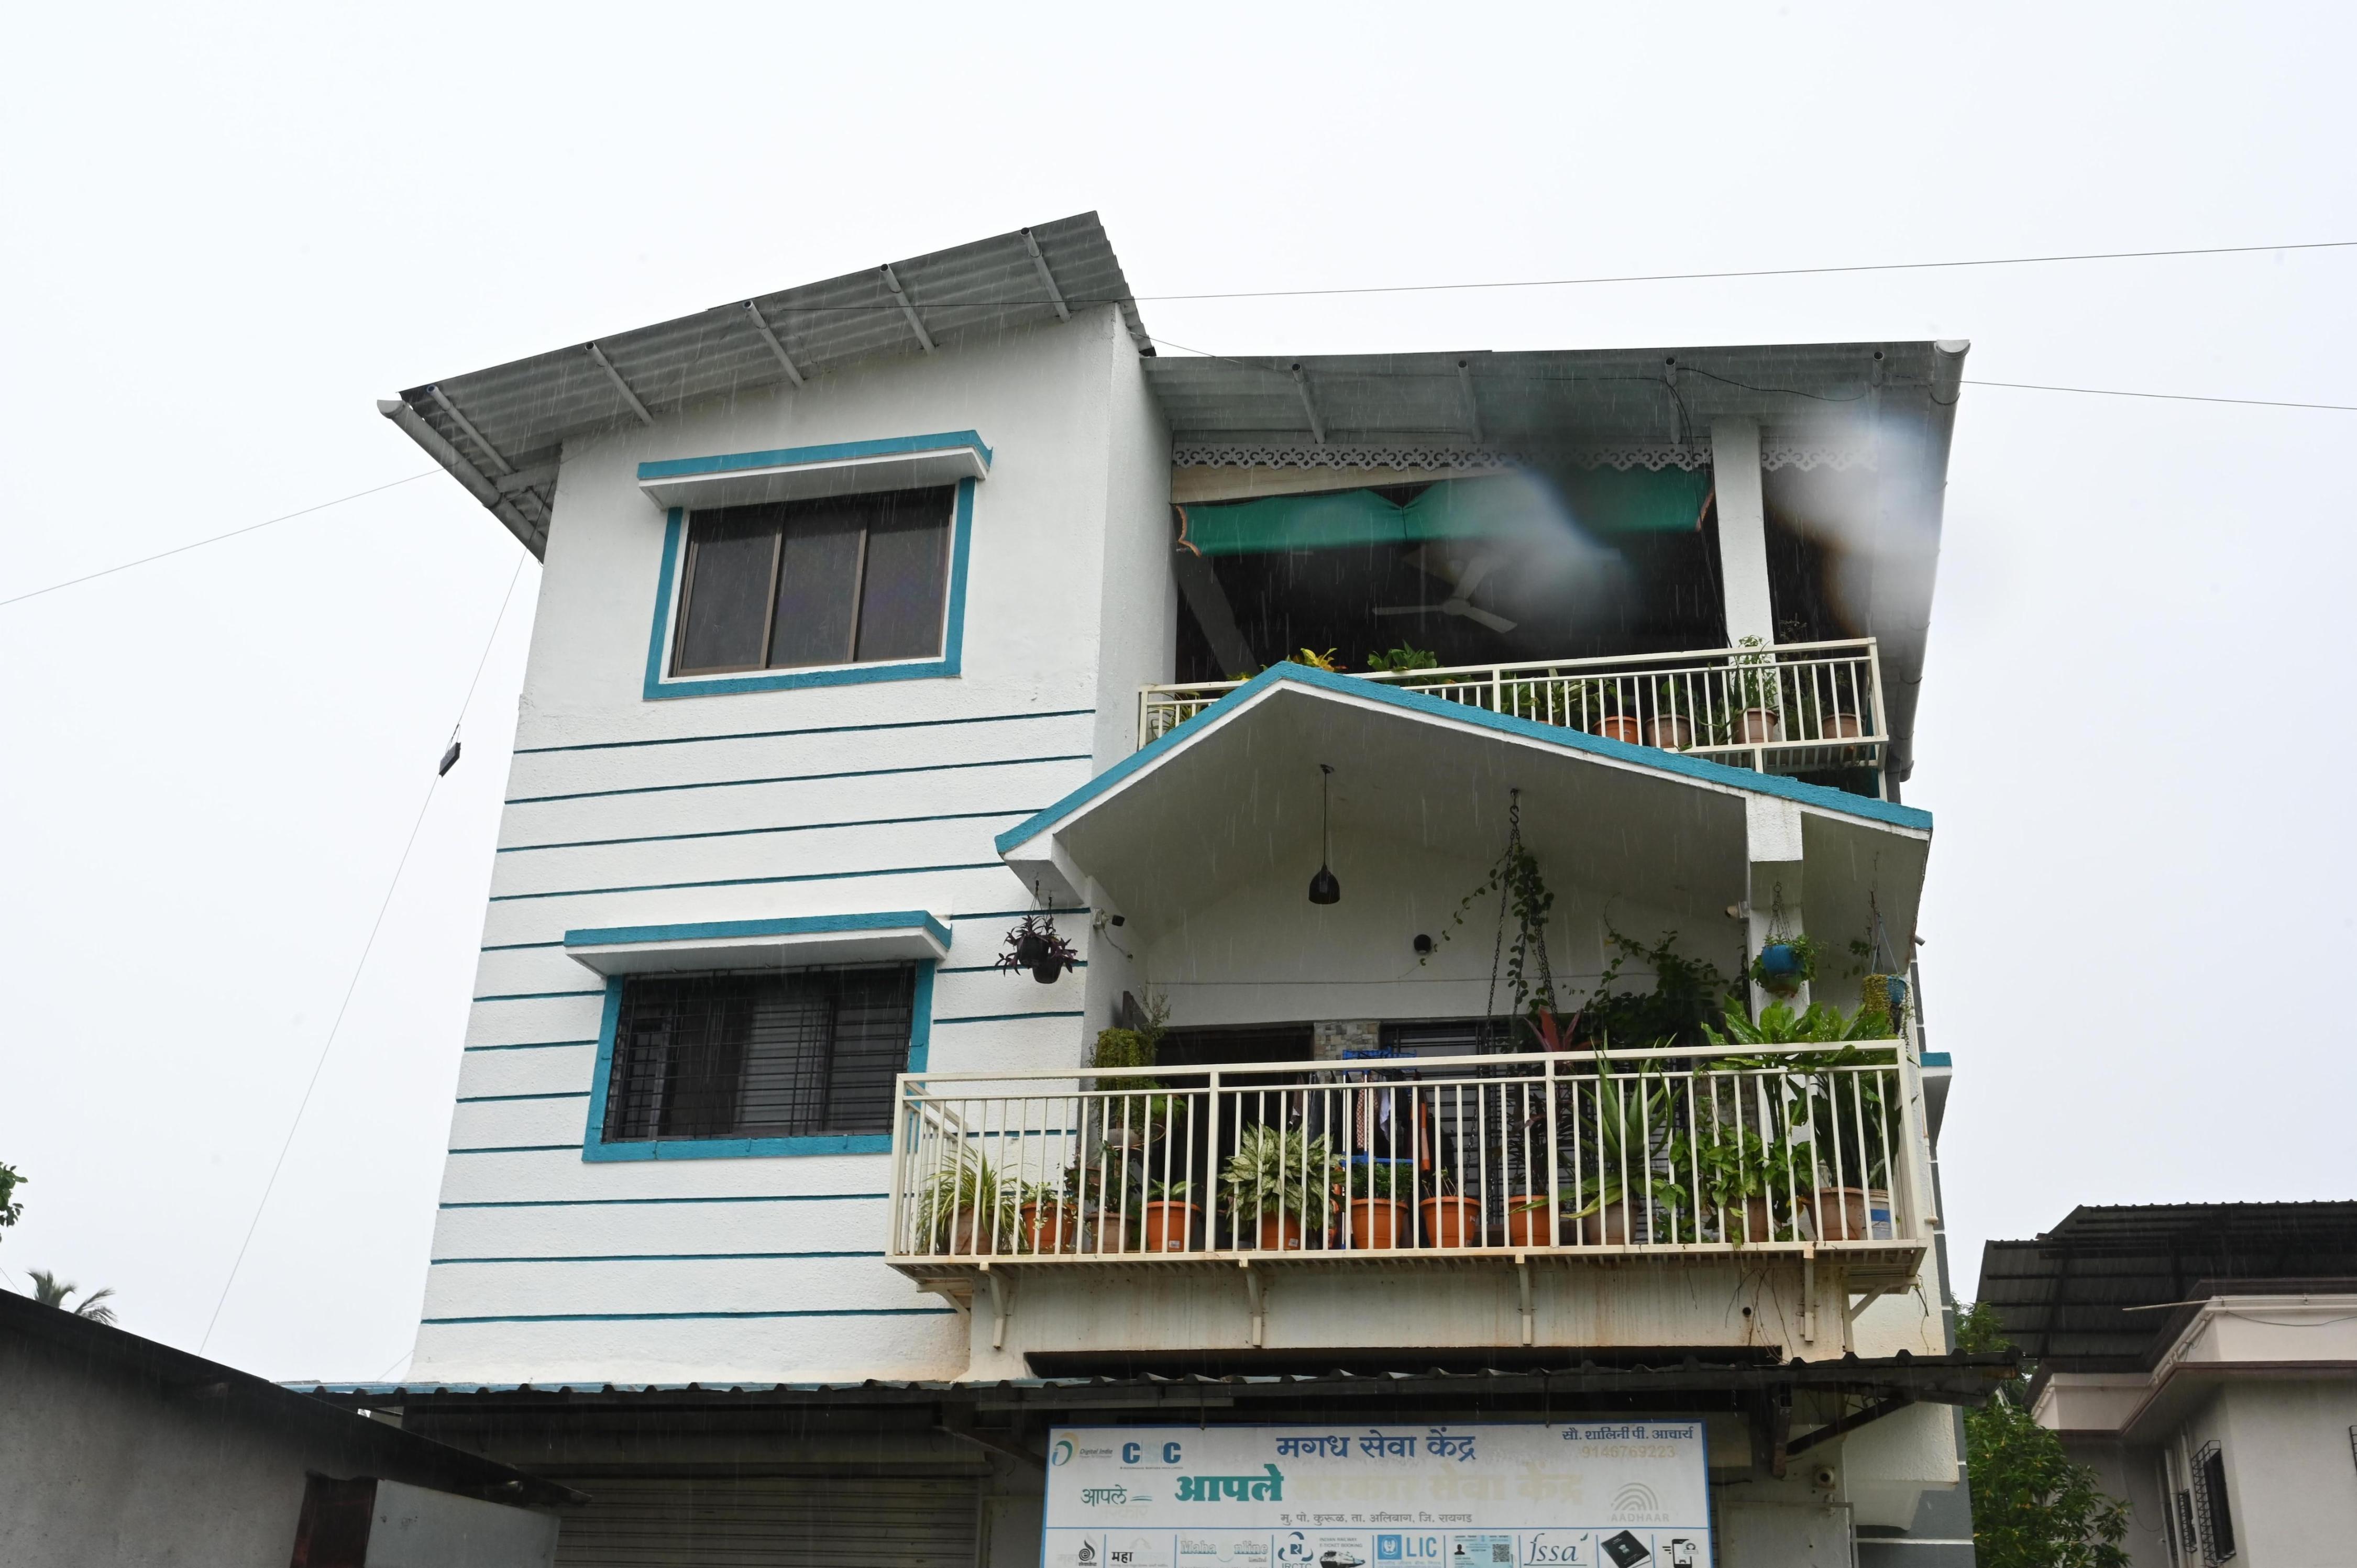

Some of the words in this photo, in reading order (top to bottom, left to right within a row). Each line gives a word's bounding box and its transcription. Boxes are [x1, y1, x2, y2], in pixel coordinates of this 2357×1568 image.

[1562, 1427, 1582, 1440] सौ.
[1585, 1427, 1629, 1440] शालिनी
[1632, 1426, 1649, 1439] पी.
[1652, 1426, 1694, 1439] आचार्य
[1276, 1435, 1350, 1458] मगध
[1359, 1429, 1417, 1458] सेवा
[1425, 1427, 1477, 1462] केंद्र
[1174, 1463, 1284, 1501] आपले
[1081, 1484, 1127, 1507] आपले
[1280, 1514, 1292, 1526] मु.
[1296, 1511, 1309, 1522] पो.
[1351, 1514, 1365, 1522] ता.
[1370, 1511, 1415, 1523] अलिबाग,
[1418, 1511, 1435, 1522] जि.
[1438, 1514, 1473, 1523] रायगड
[1611, 1513, 1670, 1522] AADHAAR
[1406, 1537, 1437, 1558] LIC
